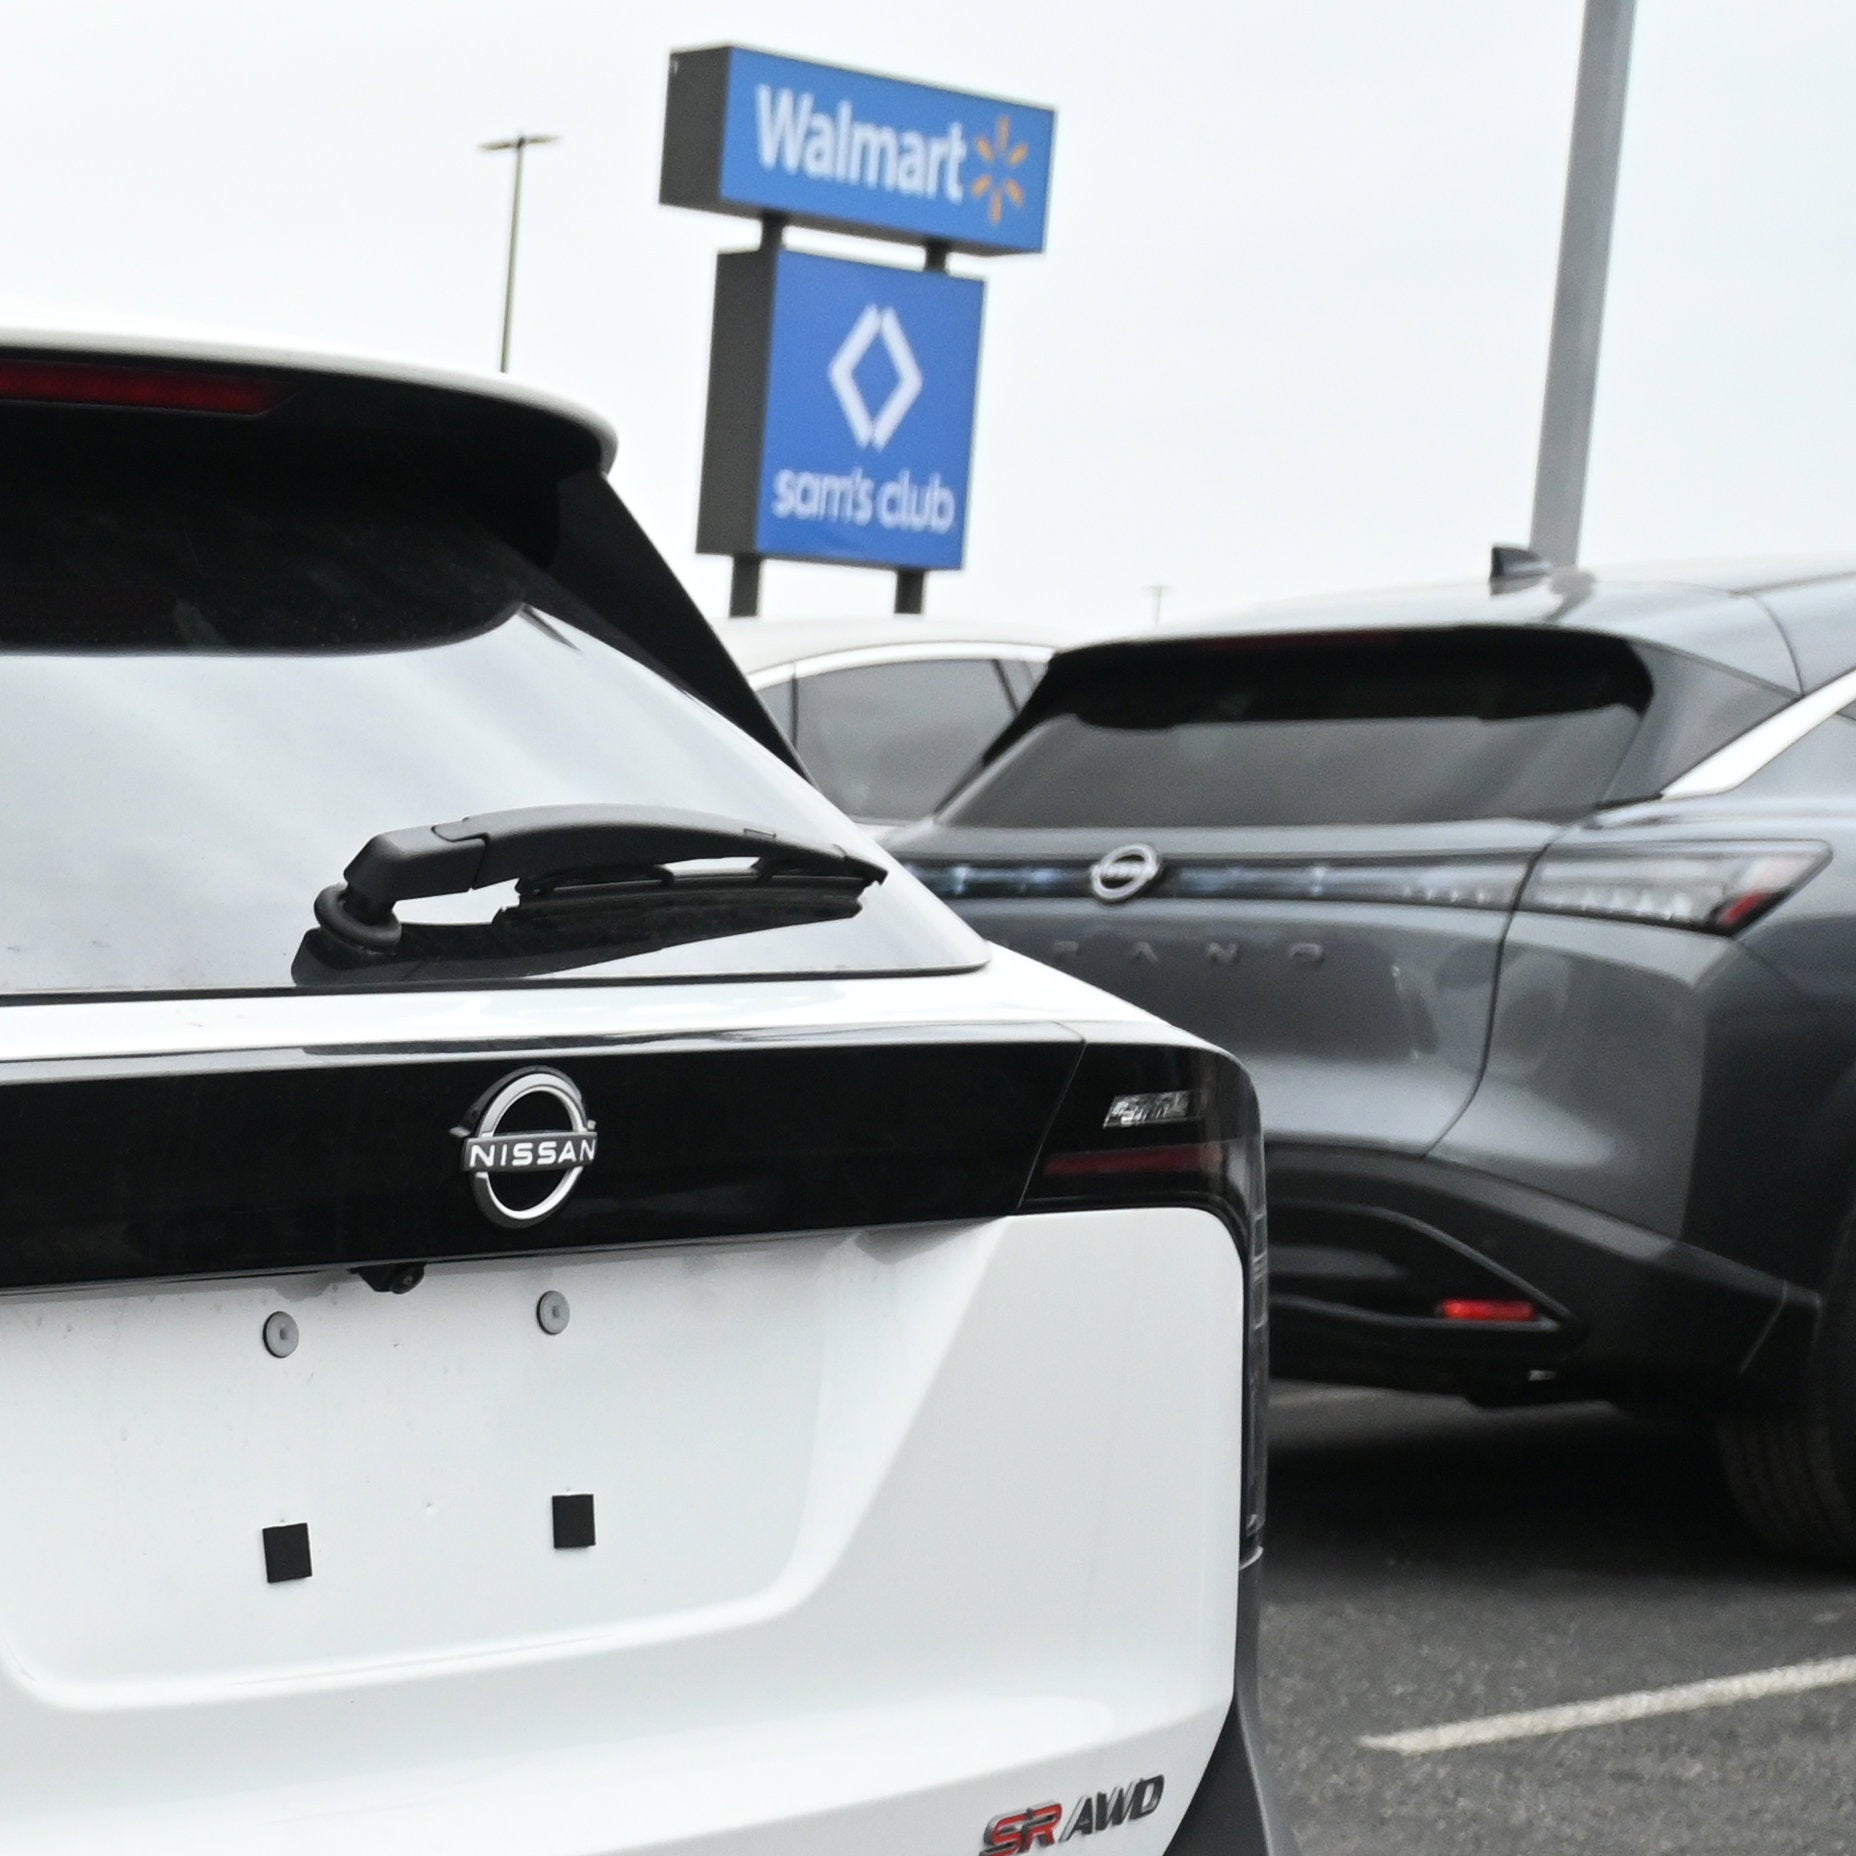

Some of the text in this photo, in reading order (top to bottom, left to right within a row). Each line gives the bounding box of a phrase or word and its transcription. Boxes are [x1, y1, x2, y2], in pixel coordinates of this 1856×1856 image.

[756, 83, 967, 205] Walmart
[772, 466, 955, 534] sam's club
[469, 1139, 596, 1168] NISSAN
[1059, 1774, 1165, 1843] AWD
